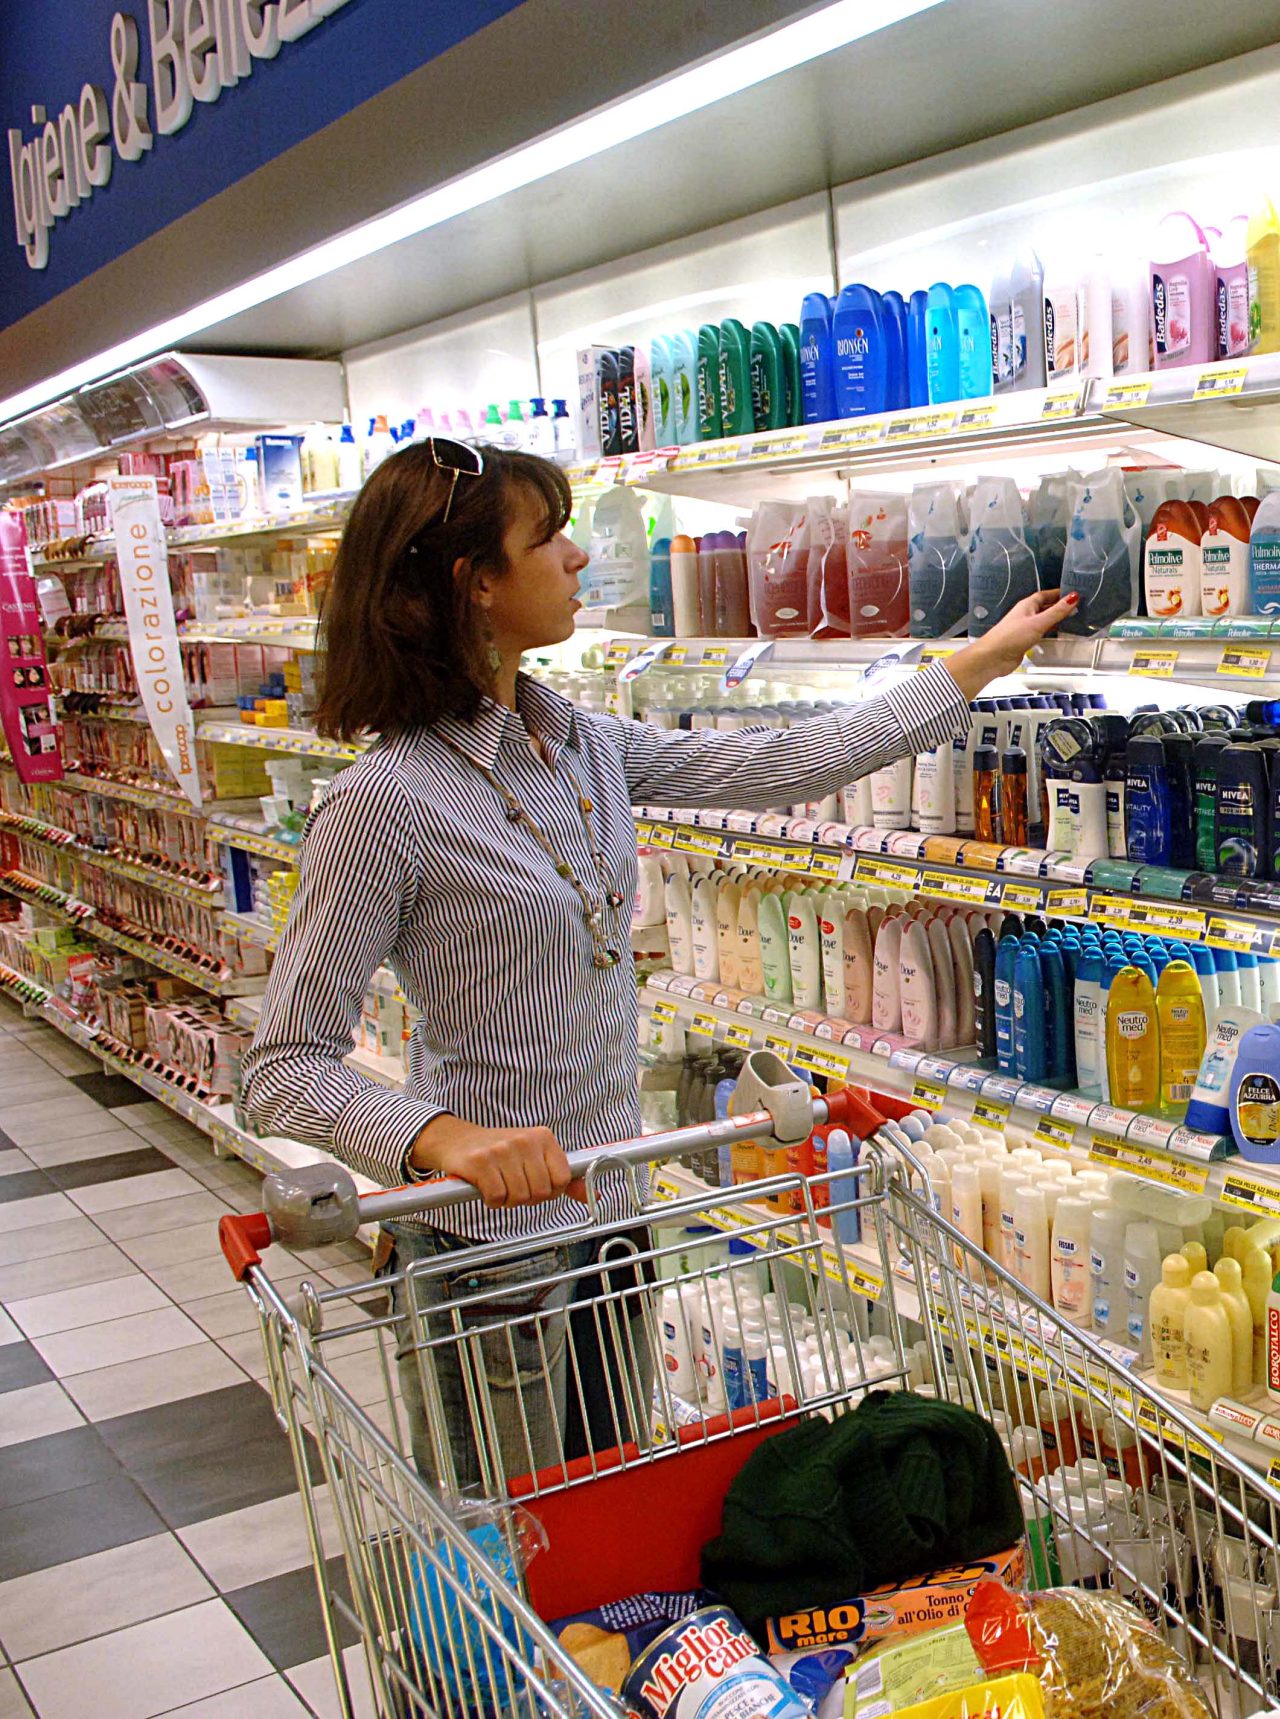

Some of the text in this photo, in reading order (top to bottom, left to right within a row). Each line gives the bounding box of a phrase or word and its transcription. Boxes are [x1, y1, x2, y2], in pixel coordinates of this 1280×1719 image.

[8, 0, 350, 270] Igiene & Bellez
[1155, 282, 1165, 345] Badedas
[1218, 285, 1227, 348] Badedas
[837, 337, 869, 356] BIONSEN
[620, 386, 632, 440] VIDAL
[1151, 566, 1179, 575] Naturals
[129, 523, 174, 713] colorazione
[1127, 778, 1147, 788] NIVEA
[1222, 790, 1249, 800] NIVEA
[1219, 825, 1255, 837] energy
[737, 925, 754, 937] Dove
[1117, 1016, 1148, 1026] Neutro
[1122, 1022, 1143, 1032] med
[1248, 1087, 1270, 1095] FELCE
[1269, 1108, 1278, 1134] Dolce
[1269, 1309, 1280, 1386] BOROTALCO
[925, 1593, 964, 1607] Tonno
[780, 1605, 860, 1639] RIO
[898, 1605, 960, 1625] all'Olio di
[796, 1631, 848, 1647] mare
[704, 1633, 758, 1680] cane
[641, 1617, 730, 1719] Miglior
